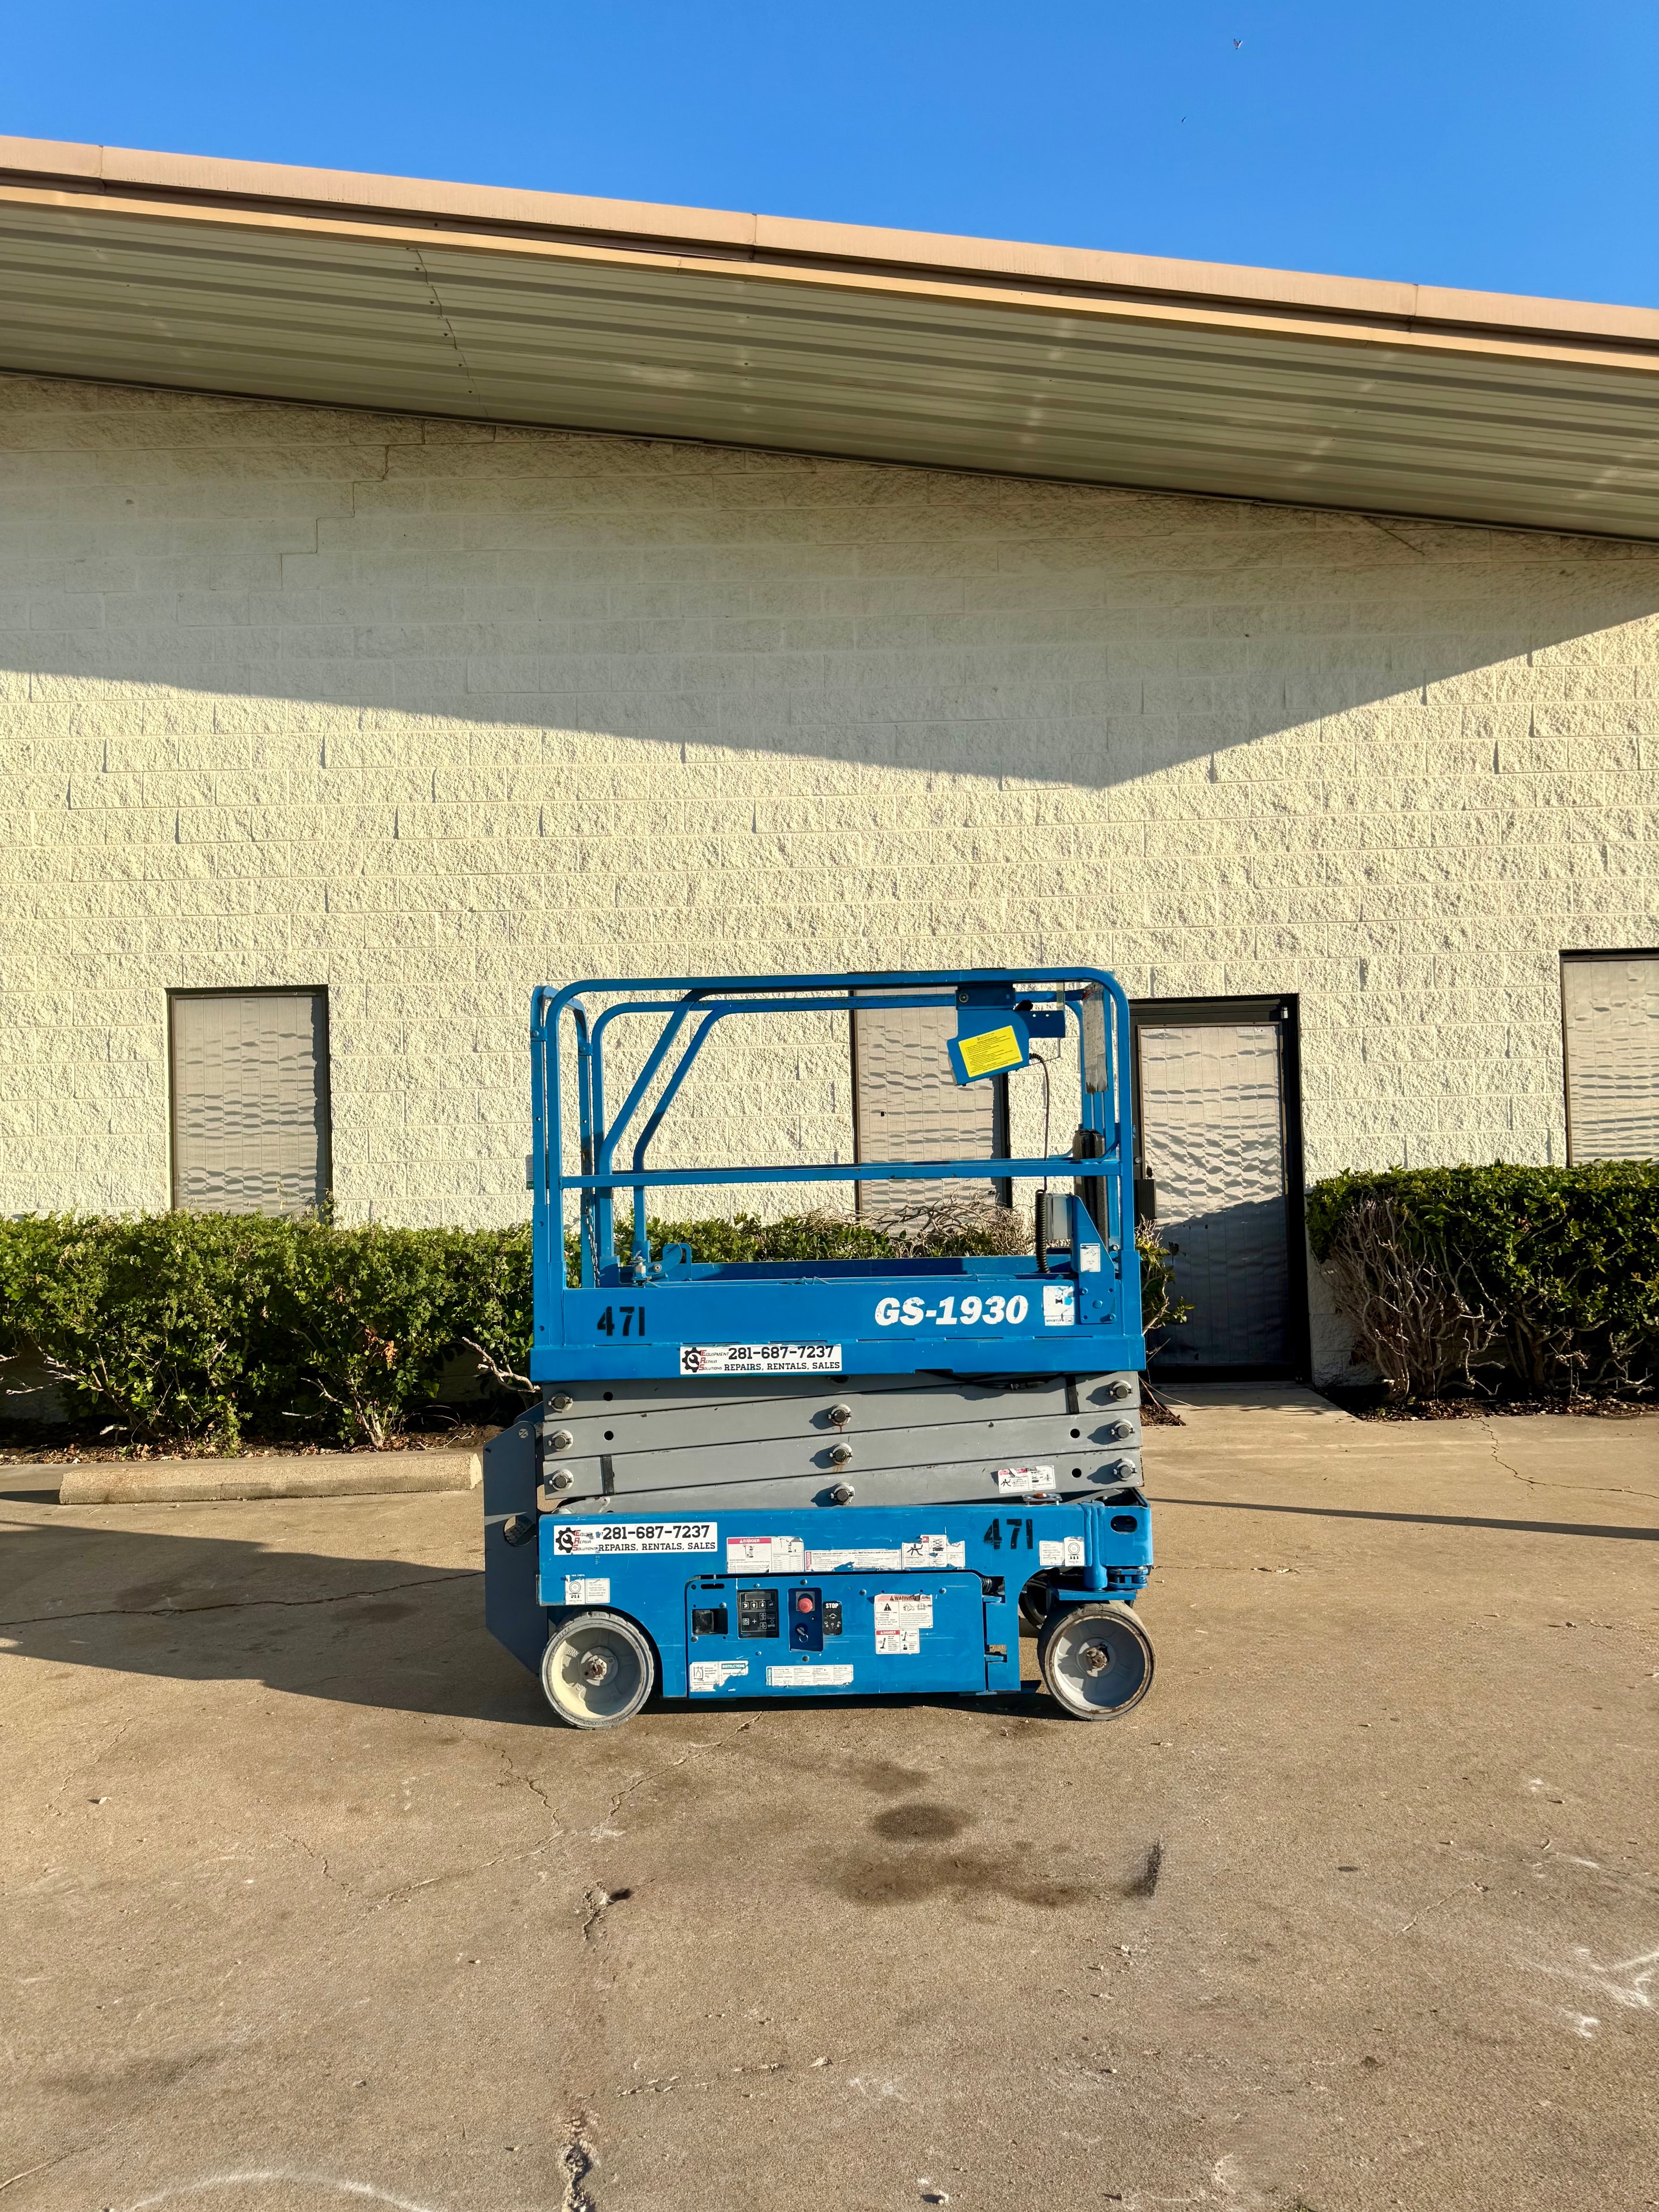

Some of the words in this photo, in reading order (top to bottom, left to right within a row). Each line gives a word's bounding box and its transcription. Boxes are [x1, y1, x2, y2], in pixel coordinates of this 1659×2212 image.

[597, 1306, 645, 1336] 471
[874, 1295, 1028, 1326] GS-1930
[728, 1346, 834, 1360] 281-687-7237
[603, 1525, 710, 1540] 281-687-7237
[983, 1518, 1033, 1550] 471
